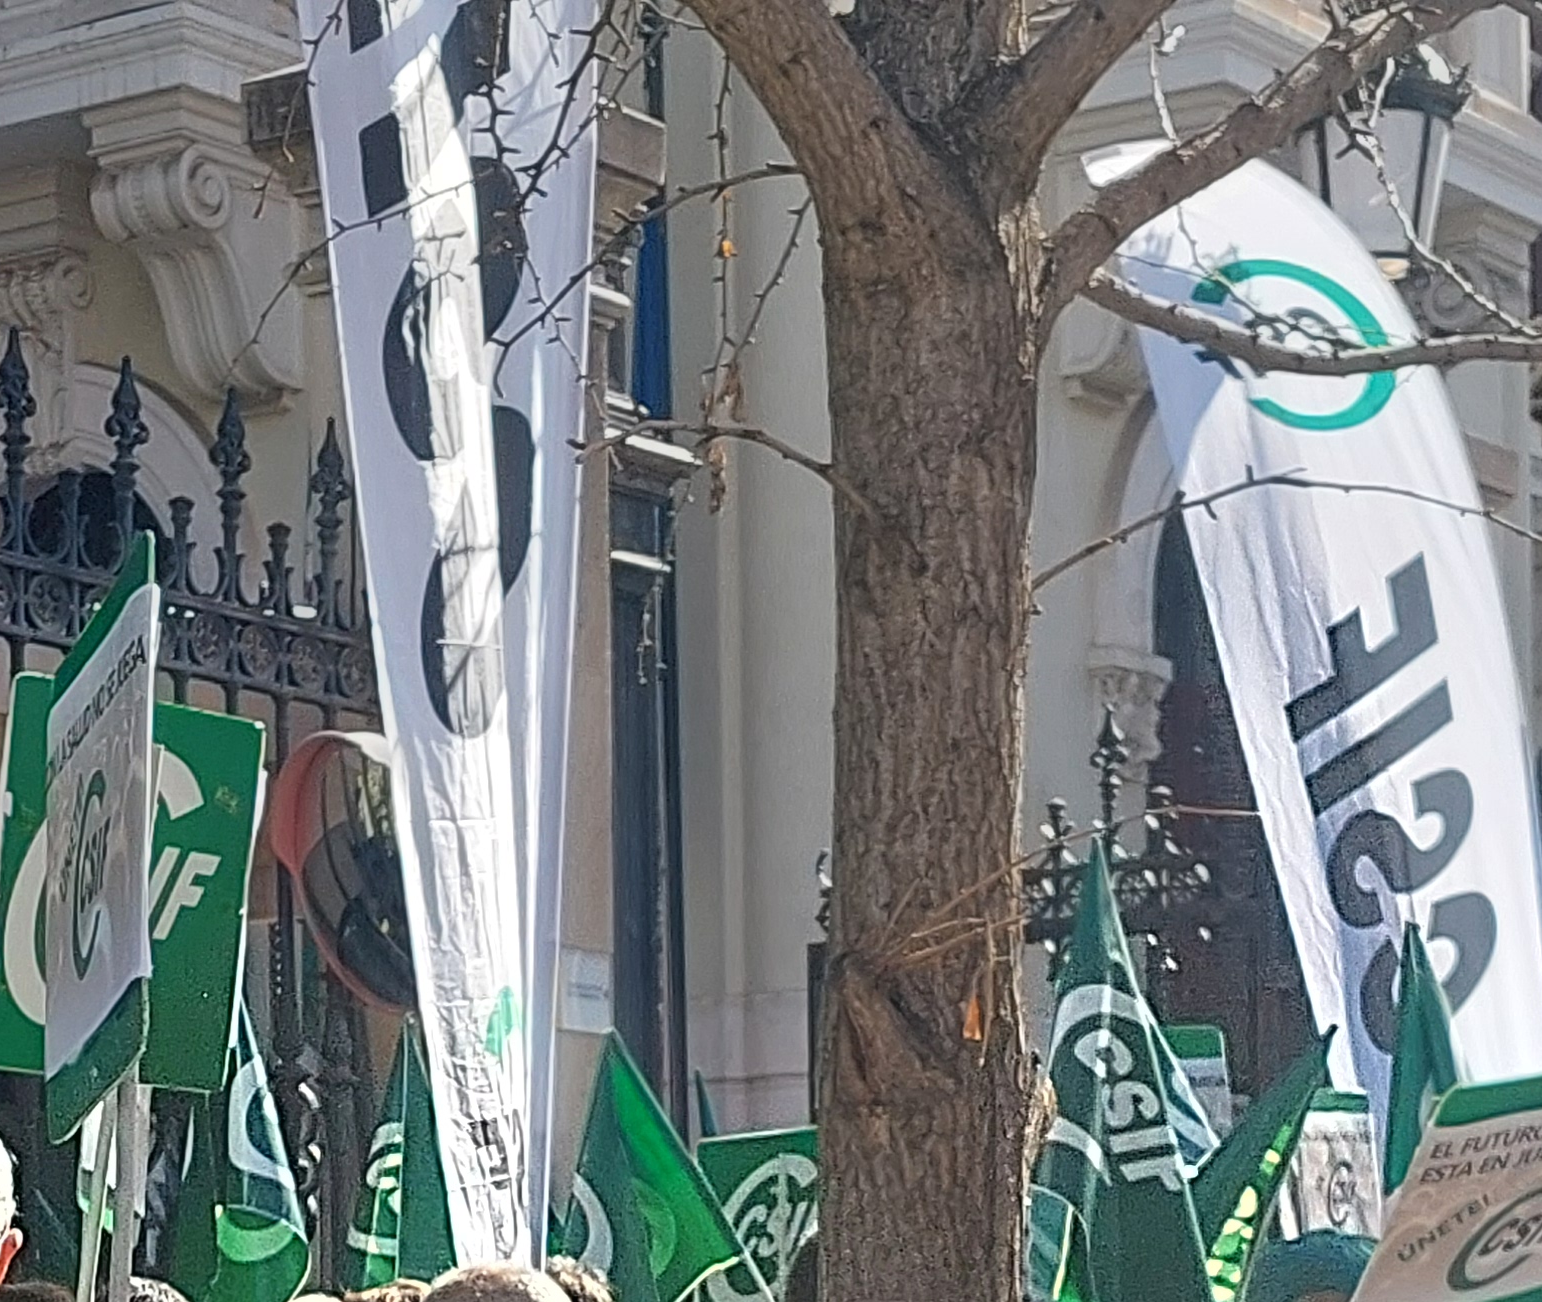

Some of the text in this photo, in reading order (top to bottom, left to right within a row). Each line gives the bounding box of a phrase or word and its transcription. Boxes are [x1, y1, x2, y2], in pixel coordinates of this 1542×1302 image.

[1074, 1029, 1182, 1191] CSIF
[1430, 1143, 1454, 1159] EL
[1419, 1162, 1472, 1184] ESTA
[1479, 1154, 1511, 1172] EN
